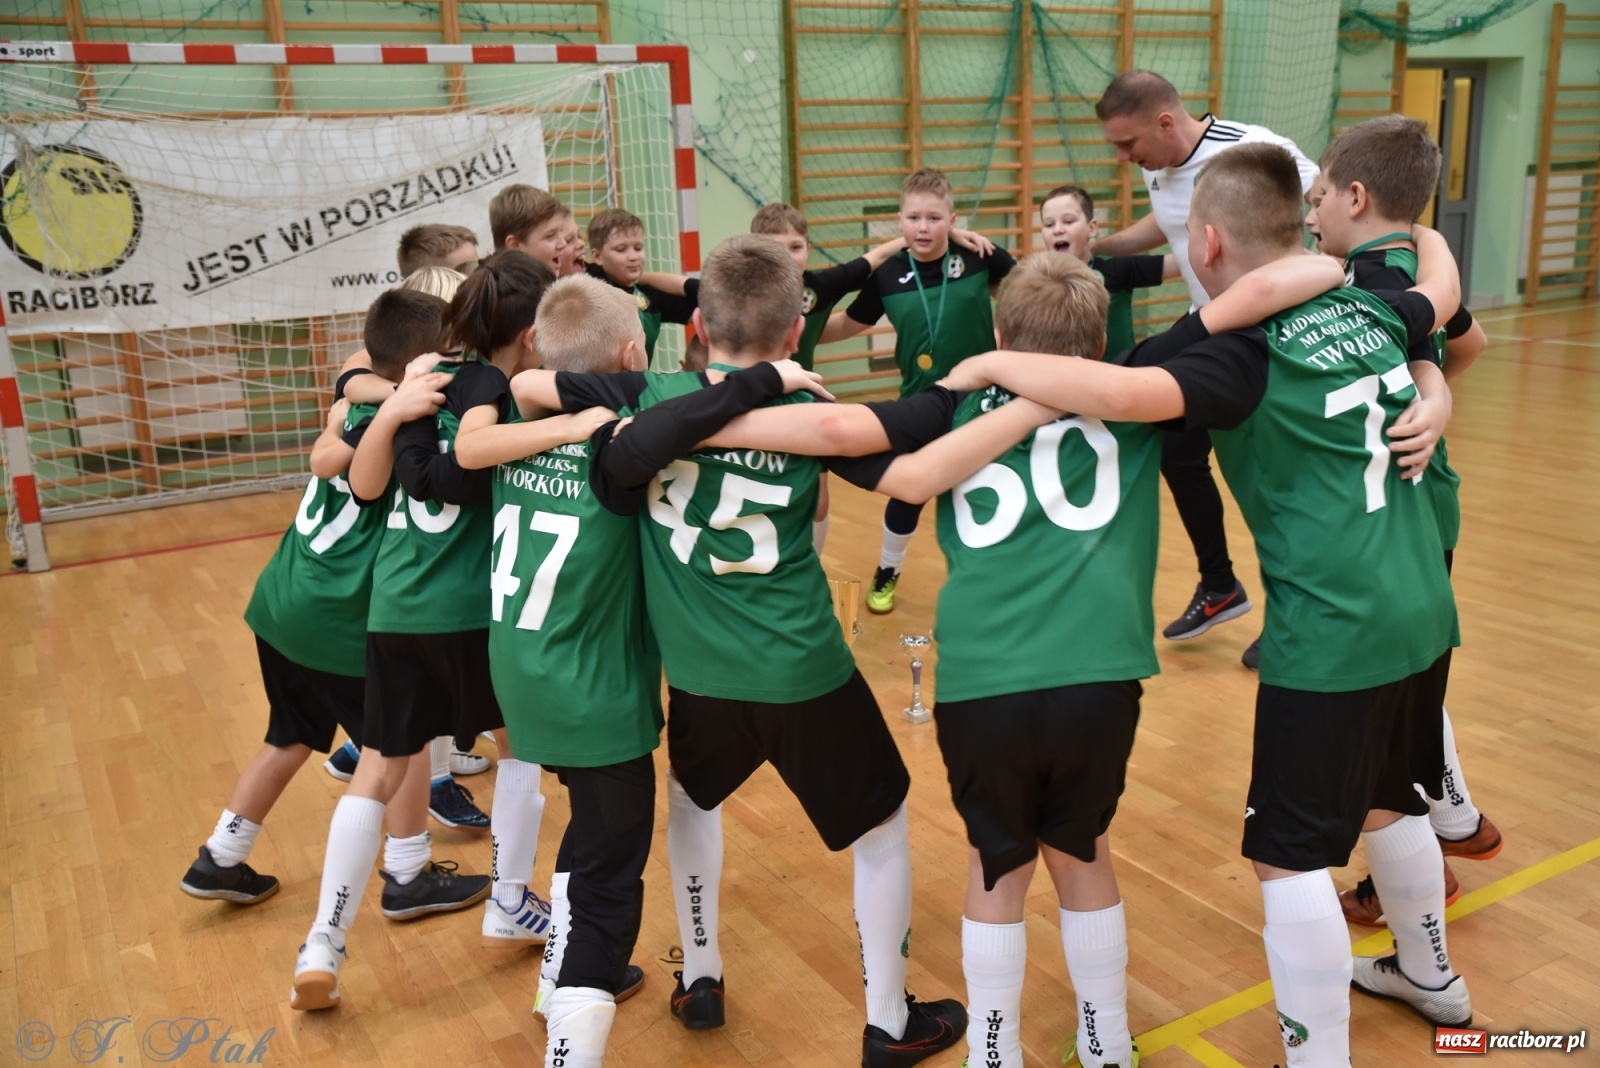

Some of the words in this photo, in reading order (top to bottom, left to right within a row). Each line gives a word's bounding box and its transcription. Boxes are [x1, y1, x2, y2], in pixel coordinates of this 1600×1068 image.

[19, 46, 55, 58] sport
[183, 234, 270, 292] JEST
[278, 217, 315, 252] W
[320, 144, 517, 237] PORZĄDKU!
[8, 280, 157, 314] RACIBÓRZ
[497, 463, 585, 500] TWORKÓW
[647, 459, 793, 575] 45
[490, 503, 580, 632] 47
